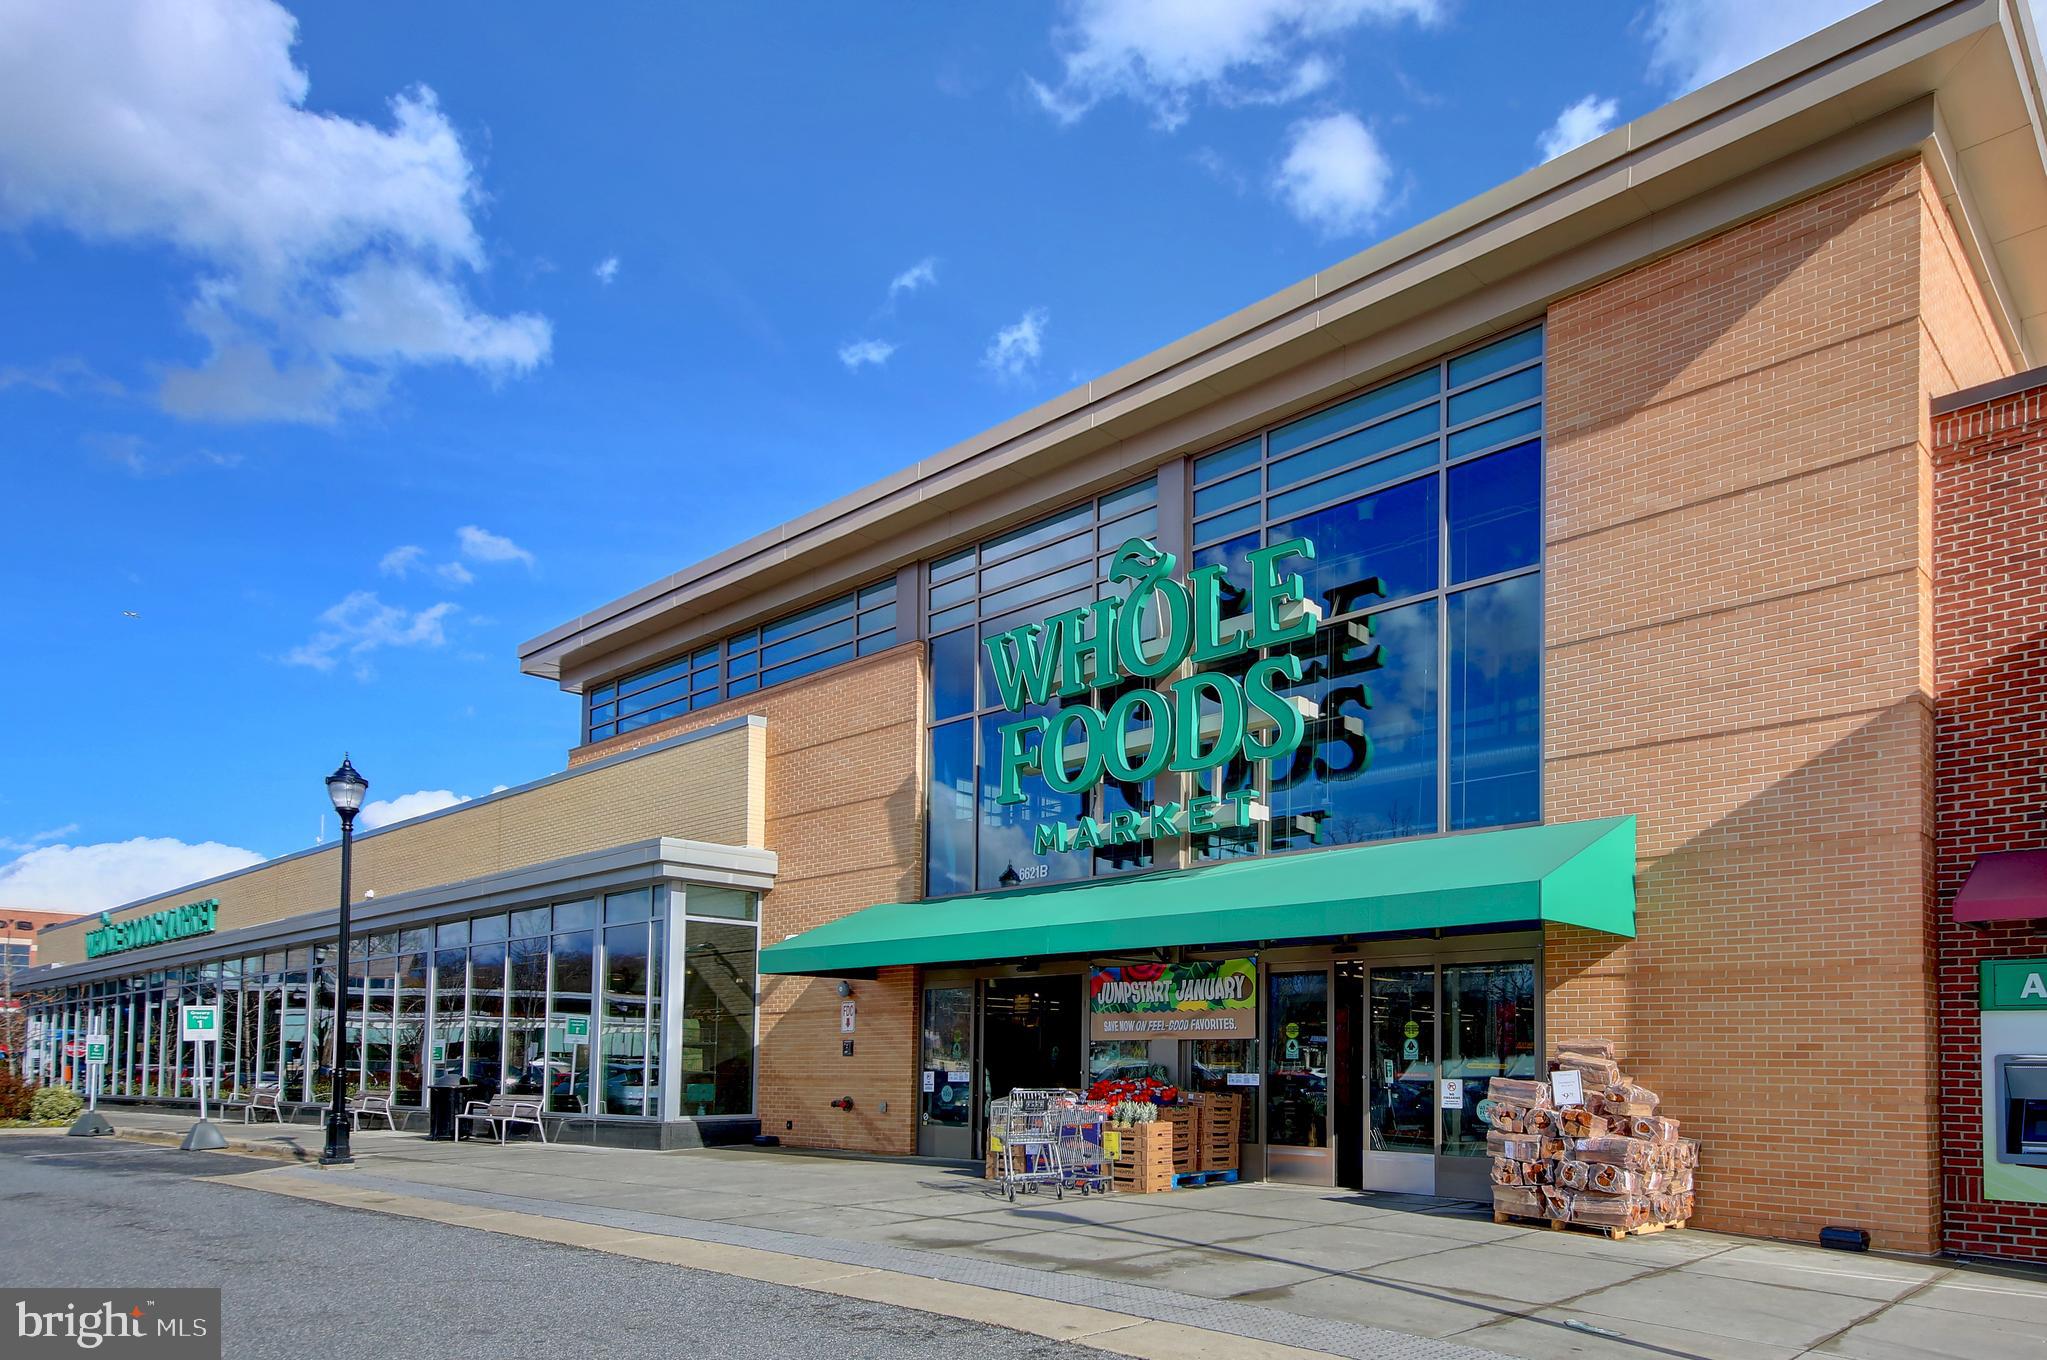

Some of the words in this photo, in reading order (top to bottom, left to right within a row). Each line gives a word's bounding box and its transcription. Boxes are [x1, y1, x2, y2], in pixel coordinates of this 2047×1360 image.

[983, 537, 1317, 713] WHOLE
[994, 653, 1306, 805] FOODS
[1034, 789, 1260, 856] MARKET
[1019, 864, 1049, 881] 6621B
[1097, 981, 1173, 1004] JUMPSTART
[1176, 975, 1247, 1002] JANUARY
[196, 1019, 203, 1029] 1
[1103, 1020, 1119, 1032] SAVE
[1119, 1020, 1135, 1032] NOW
[1135, 1020, 1147, 1032] ON
[1147, 1019, 1190, 1032] FEEL-GOOD
[1191, 1018, 1237, 1031] FAVORITES.
